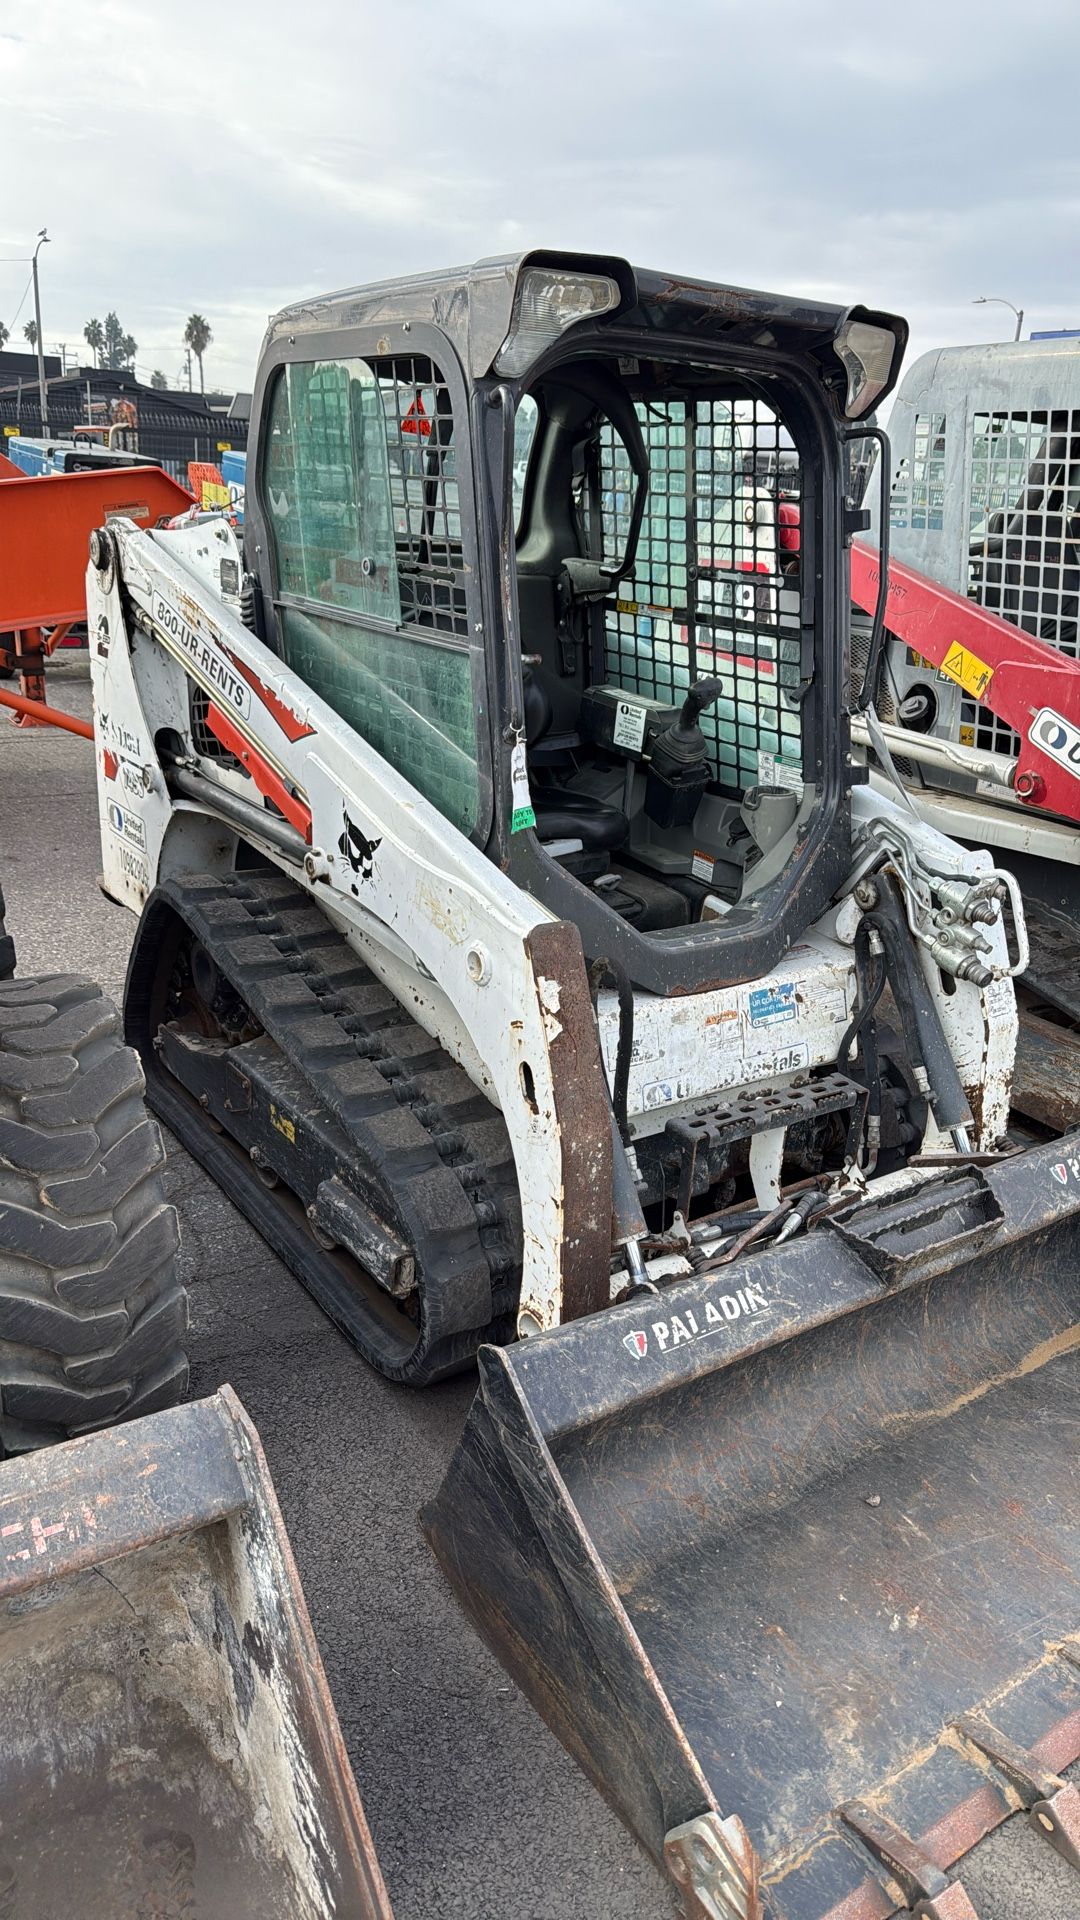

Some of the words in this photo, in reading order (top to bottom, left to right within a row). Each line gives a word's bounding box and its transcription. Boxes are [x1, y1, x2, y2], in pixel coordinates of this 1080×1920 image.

[157, 601, 245, 707] 800-UR-RENTS
[123, 811, 143, 834] United
[123, 824, 145, 849] Rentals
[651, 1282, 769, 1350] PALADIN
